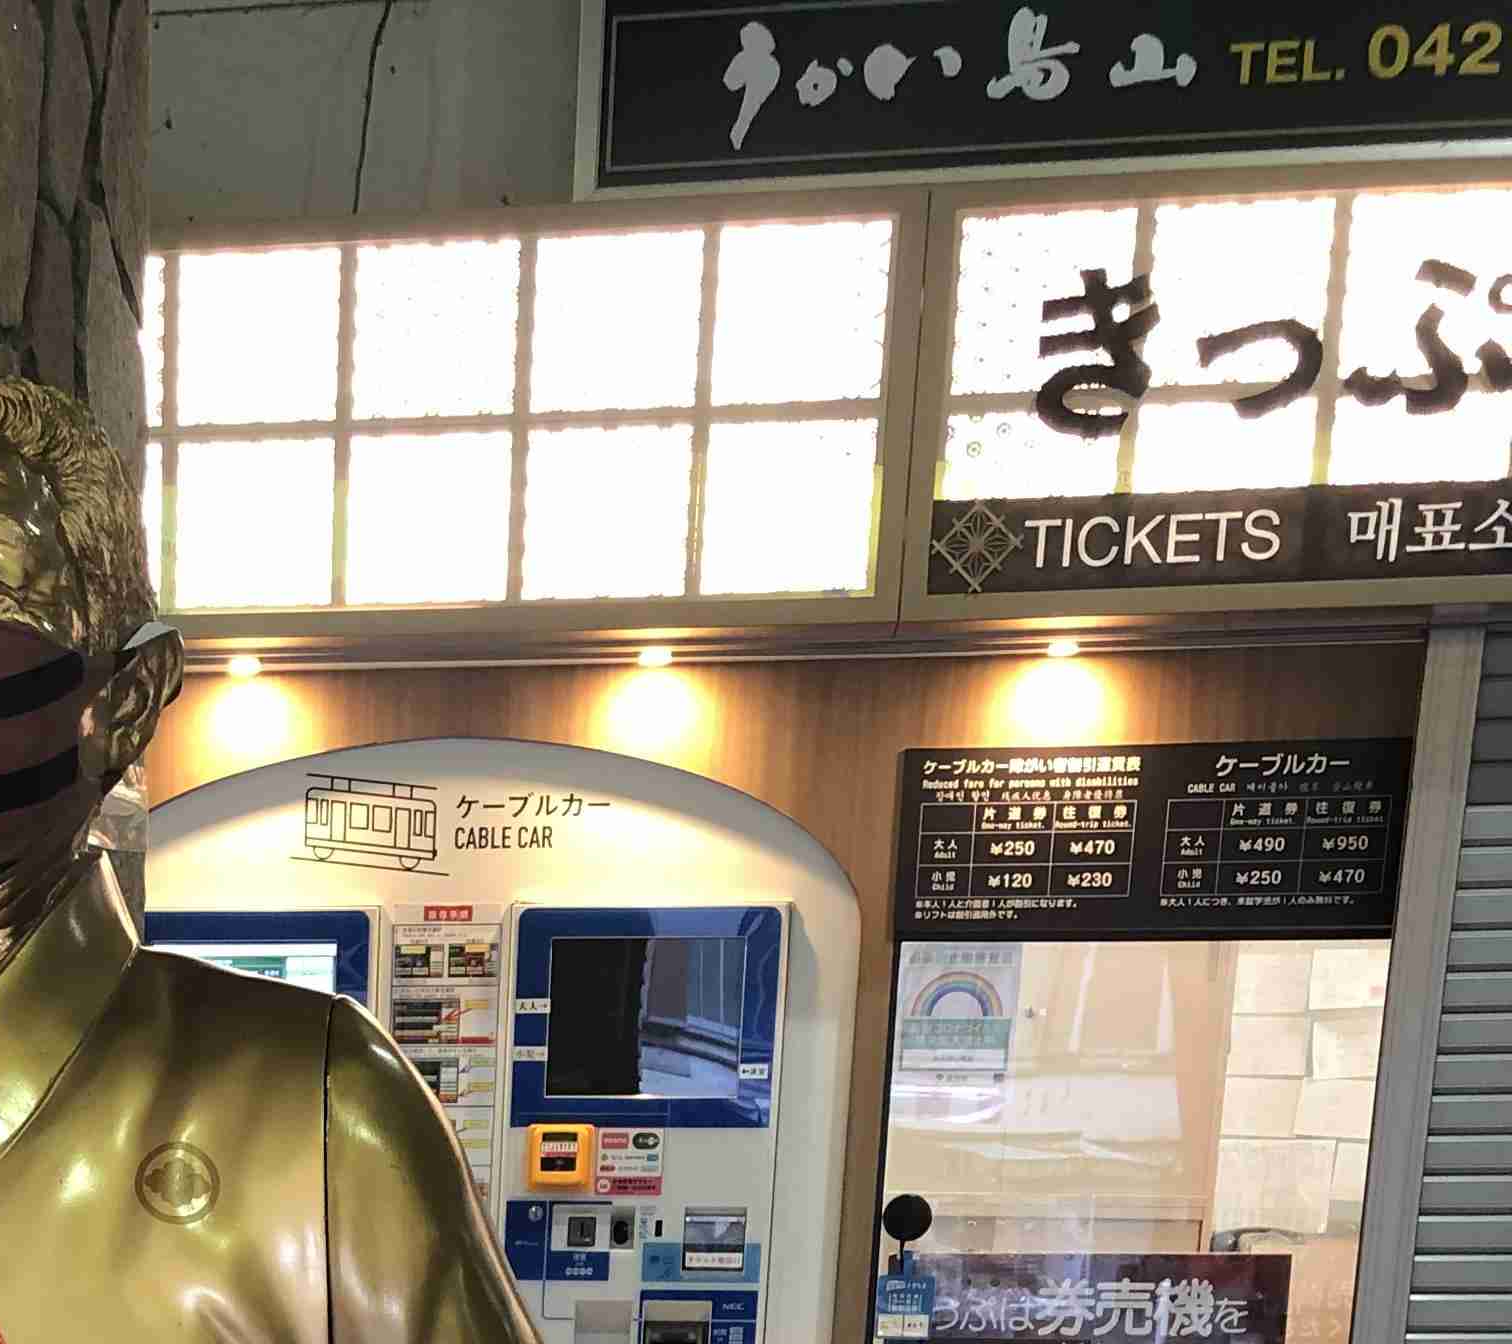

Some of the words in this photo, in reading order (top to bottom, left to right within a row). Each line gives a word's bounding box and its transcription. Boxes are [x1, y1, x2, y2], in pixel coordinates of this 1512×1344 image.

[1229, 39, 1345, 85] TEL.
[1367, 20, 1503, 79] 042
[1347, 498, 1512, 563] 매표소
[1024, 509, 1281, 568] TICKETS
[1216, 753, 1350, 777] ケーブルカー
[1188, 783, 1215, 793] CABLE
[1219, 783, 1236, 793] CAR
[456, 792, 610, 819] ケーブルカー
[455, 826, 511, 849] CABLE
[518, 826, 553, 849] CAR
[934, 839, 957, 850] 大人
[1180, 836, 1206, 847] 大人
[1240, 837, 1285, 852] ¥490
[1322, 835, 1369, 851] ¥950
[990, 841, 1035, 856] ¥250
[1070, 840, 1115, 855] ¥470
[988, 873, 1033, 888] ¥120
[1067, 872, 1113, 888] ¥230
[1236, 870, 1282, 885] ¥250
[1319, 869, 1366, 884] ¥470
